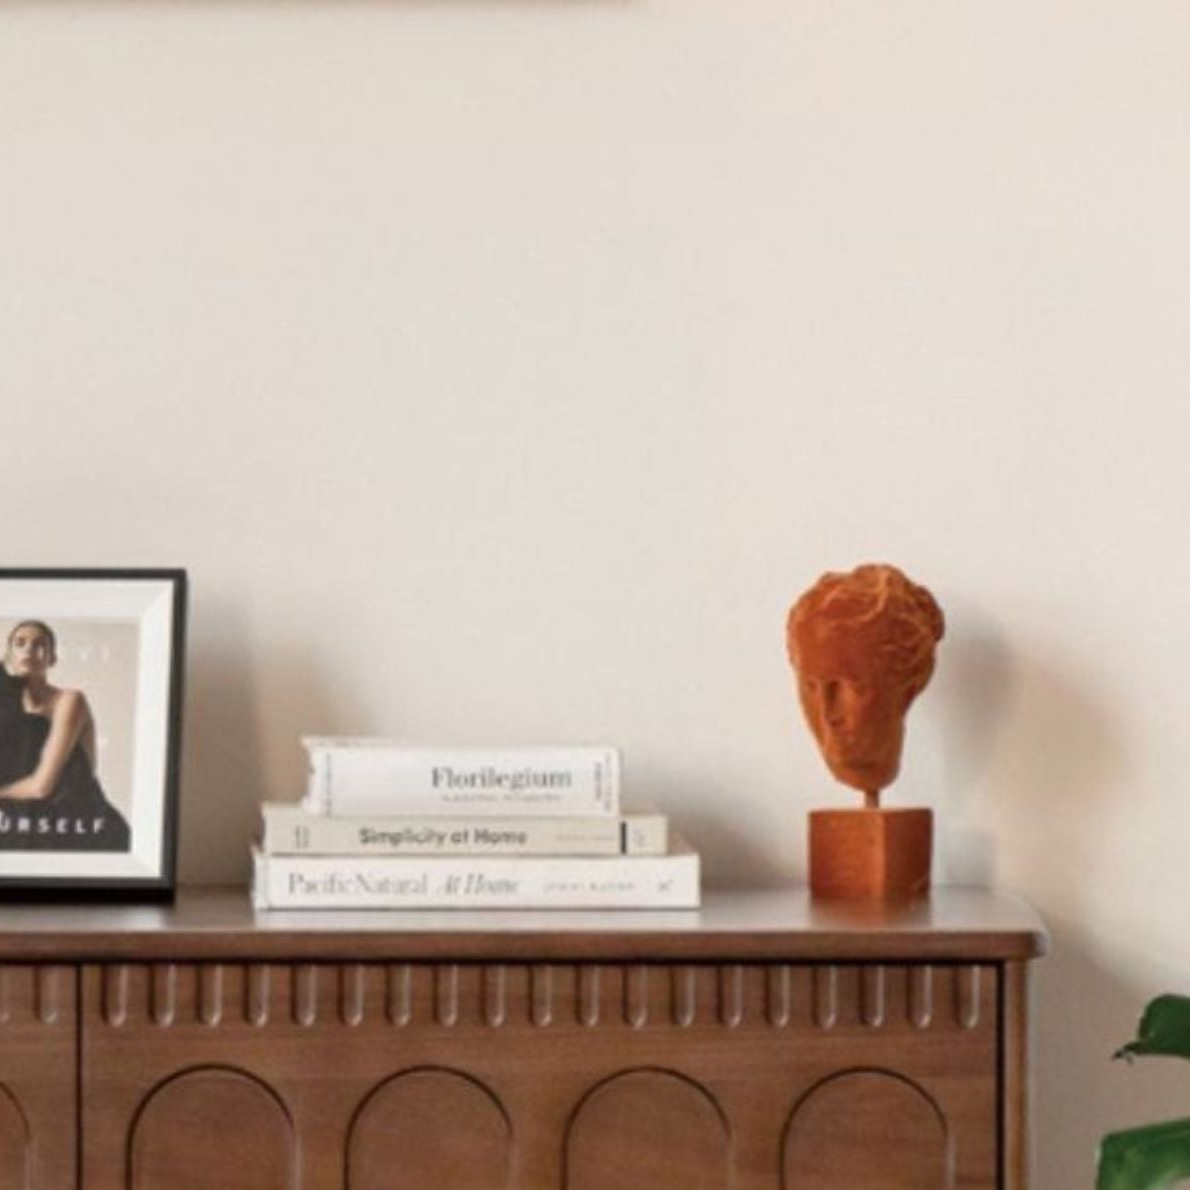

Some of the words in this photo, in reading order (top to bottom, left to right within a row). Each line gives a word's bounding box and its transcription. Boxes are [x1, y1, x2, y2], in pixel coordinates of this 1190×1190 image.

[431, 766, 573, 793] Florilegium
[358, 827, 448, 847] Simplicity
[450, 828, 469, 844] at
[473, 827, 528, 844] Home
[288, 871, 354, 895] Pacific
[355, 871, 429, 895] Natural
